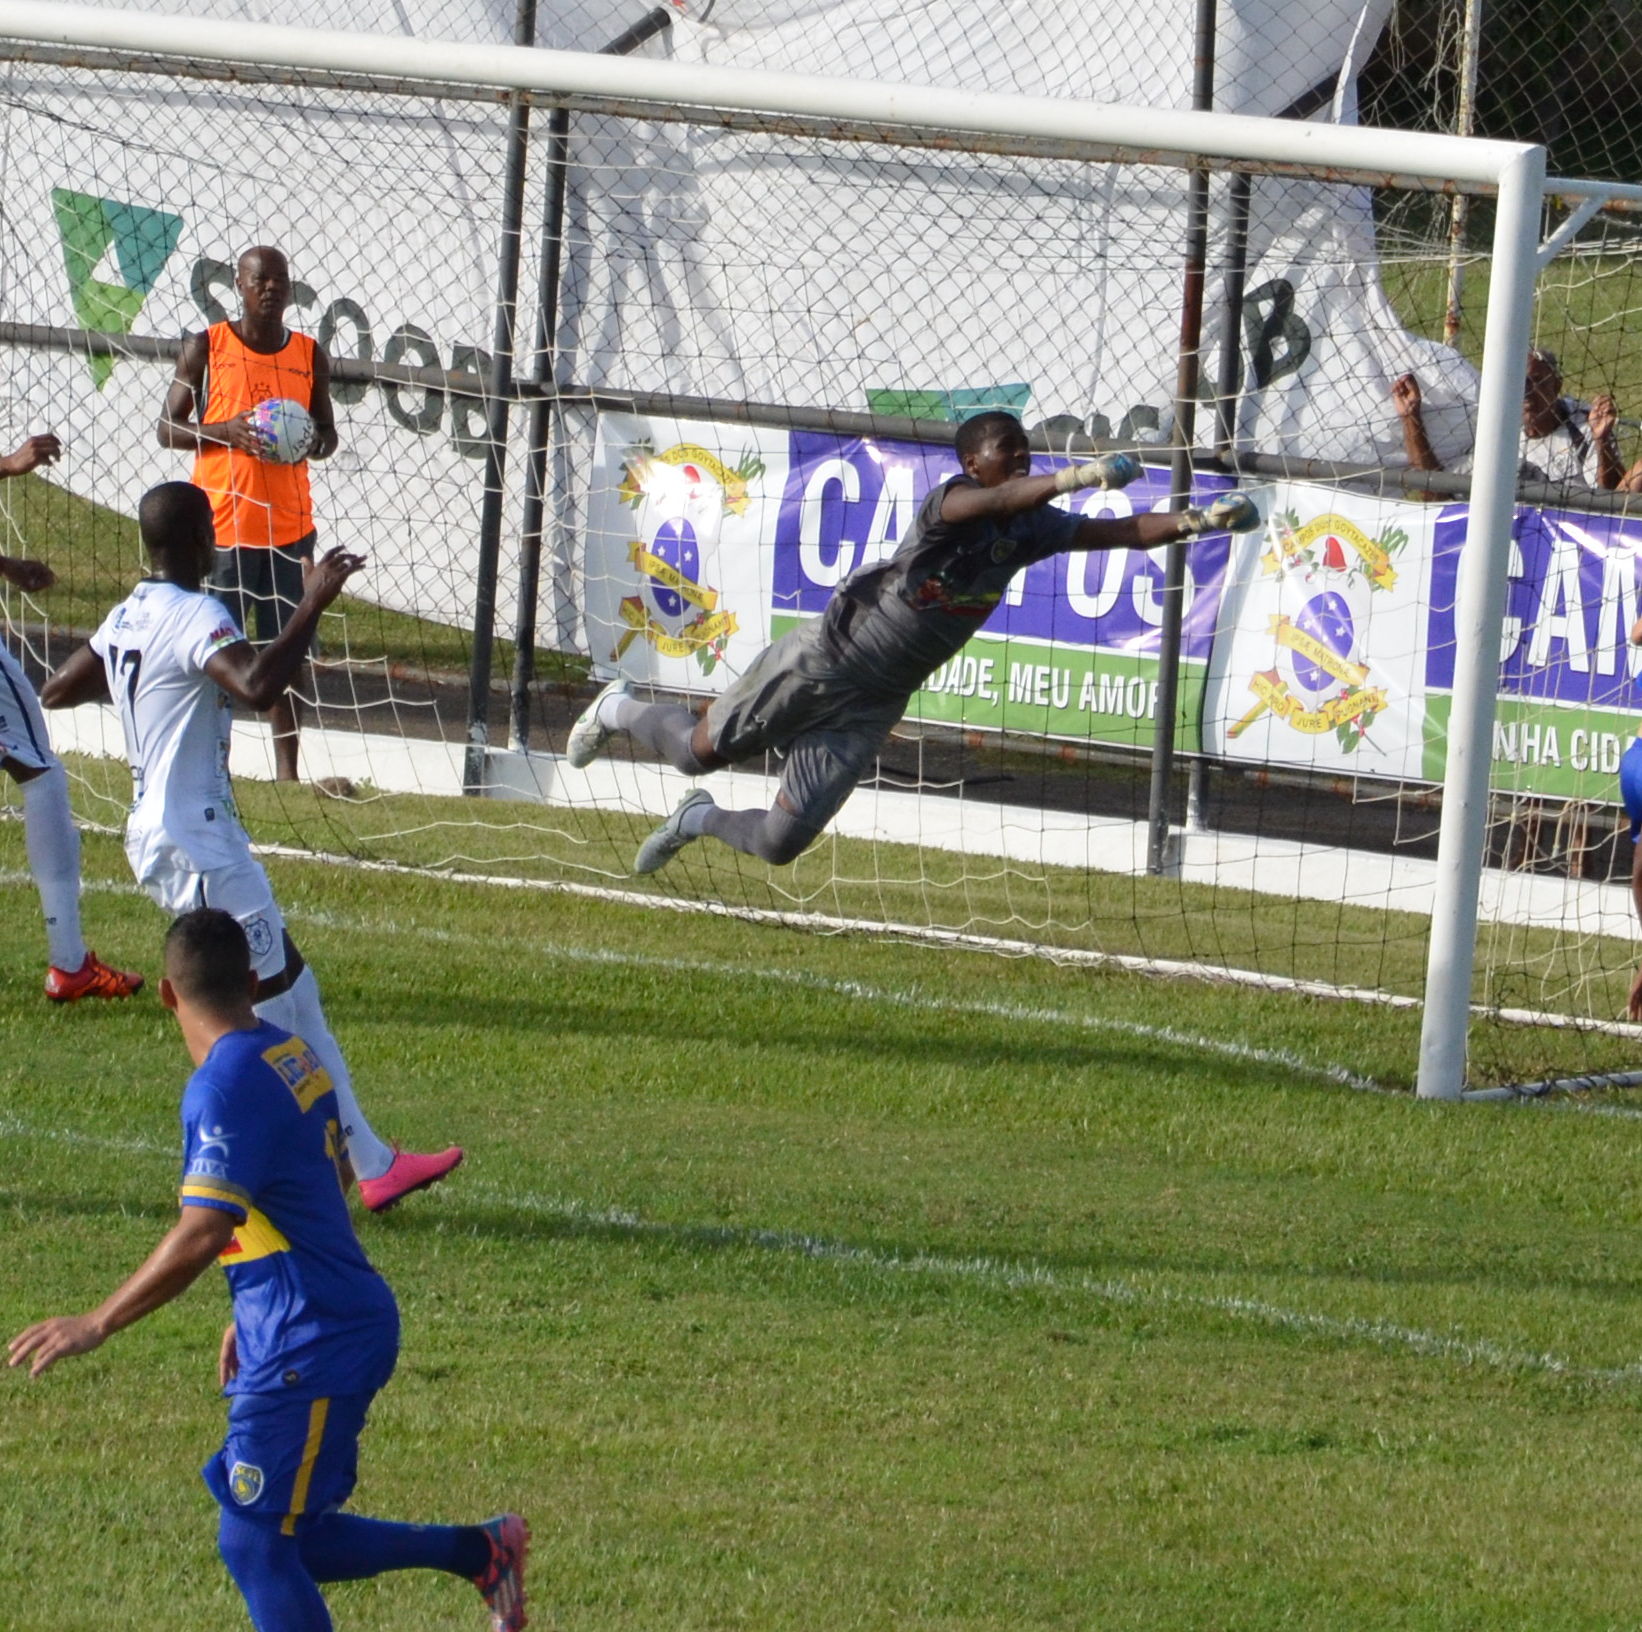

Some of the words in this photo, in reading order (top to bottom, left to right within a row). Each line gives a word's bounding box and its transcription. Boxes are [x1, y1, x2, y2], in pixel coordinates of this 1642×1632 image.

[800, 458, 1195, 629] CAOS
[919, 654, 999, 707] DADE,
[1008, 661, 1071, 710] MEU
[1493, 720, 1562, 769] NHA
